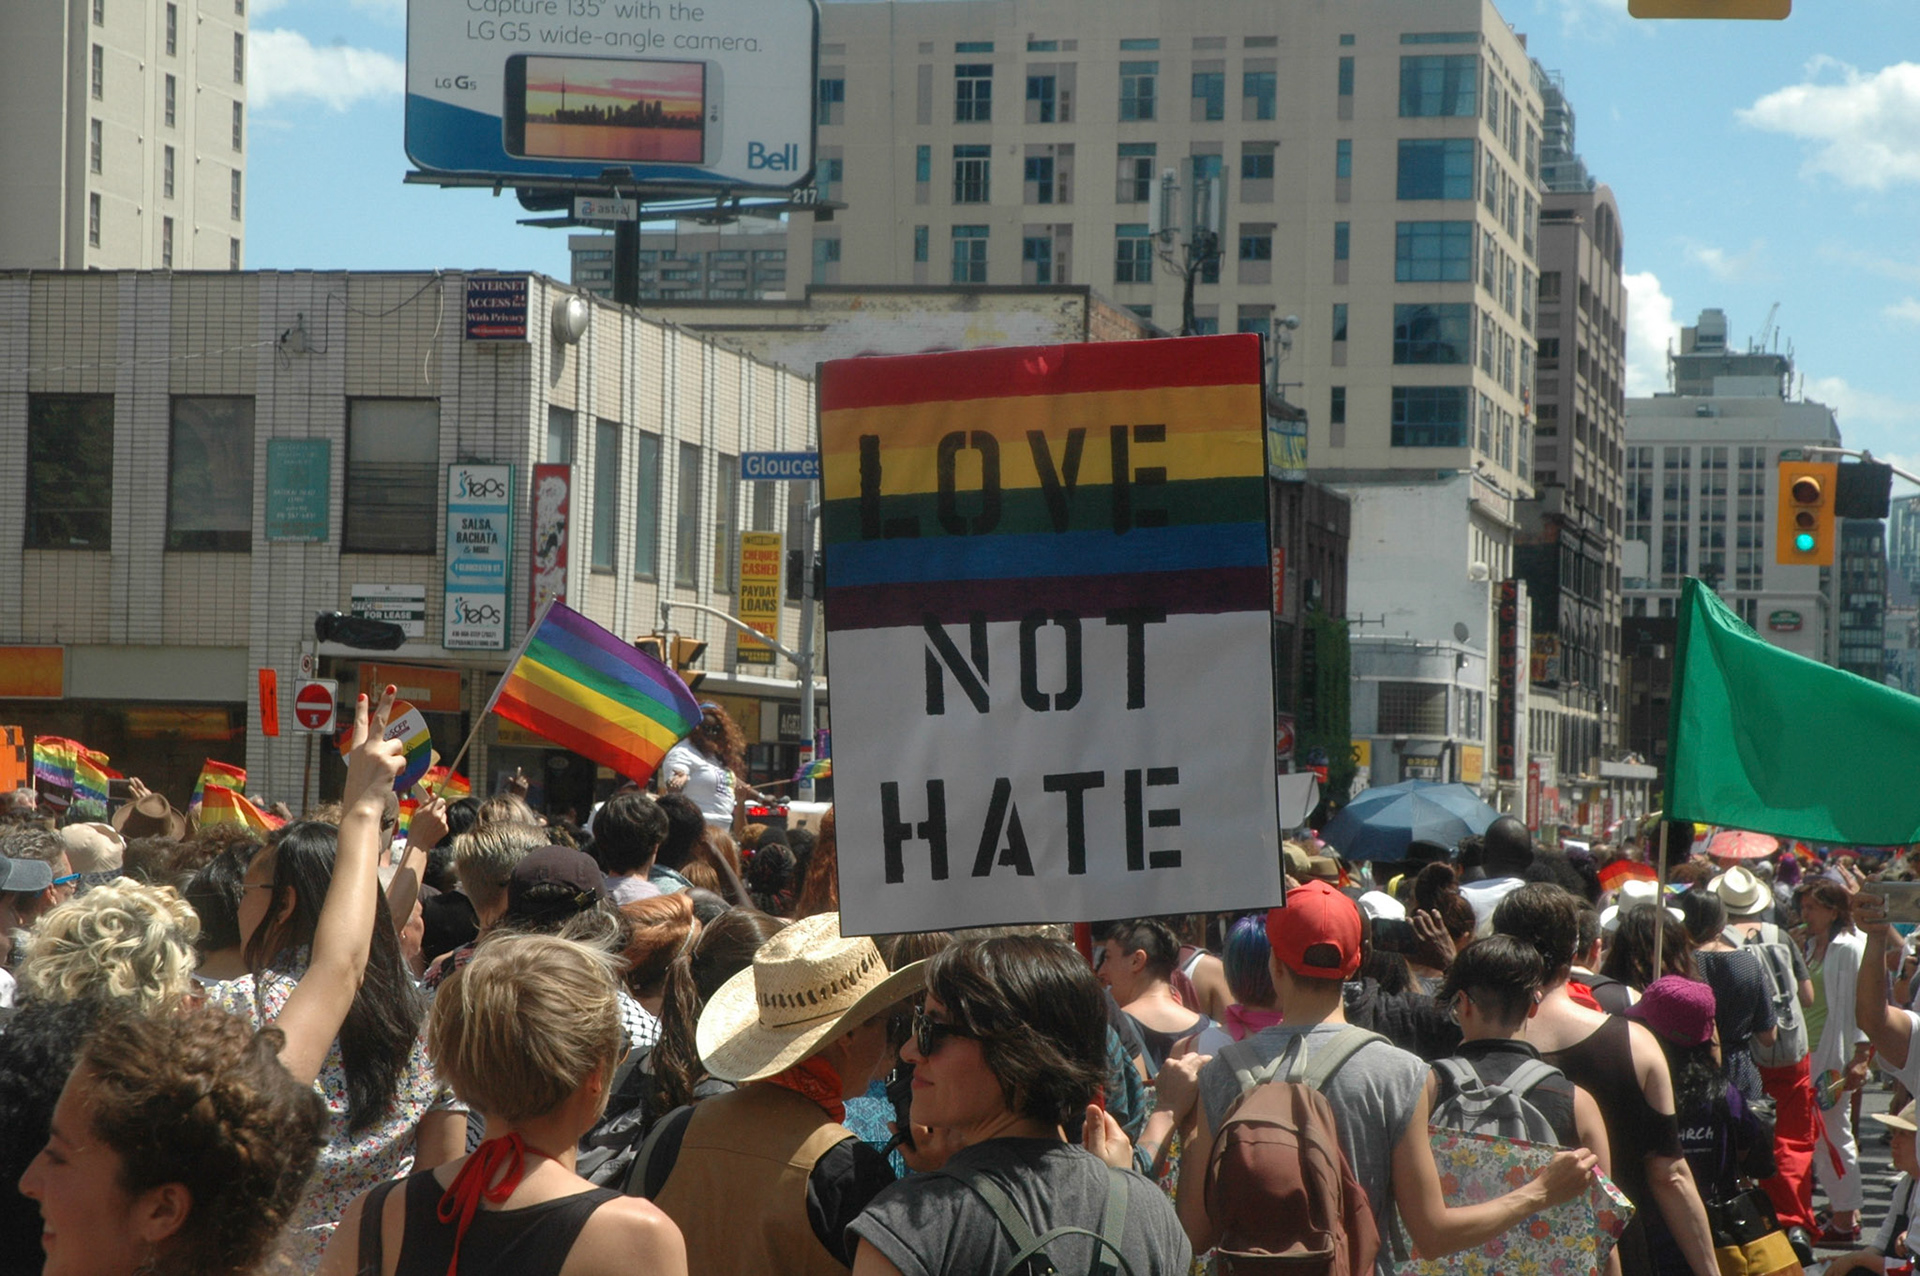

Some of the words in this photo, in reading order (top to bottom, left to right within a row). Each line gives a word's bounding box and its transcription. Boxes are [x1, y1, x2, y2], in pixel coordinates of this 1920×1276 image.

[467, 0, 558, 17] Capture
[615, 0, 661, 20] with
[669, 2, 704, 22] the
[466, 20, 495, 41] LG
[500, 22, 531, 42] G5
[540, 25, 665, 53] wide-angle
[673, 34, 763, 52] camera.
[435, 77, 452, 89] LG
[455, 75, 477, 90] G5
[748, 141, 798, 171] Bell
[792, 188, 818, 204] 217
[467, 280, 526, 291] INTERNET
[468, 297, 511, 308] ACCESS
[467, 313, 490, 322] With
[491, 313, 525, 323] Privacy
[859, 424, 1168, 541] LOVE
[456, 532, 498, 545] BACHATA
[743, 550, 780, 562] CHEQUES
[742, 563, 778, 576] CASHED
[741, 585, 777, 598] PAYDAY
[740, 599, 777, 612] LOANS
[363, 611, 382, 619] FOR
[383, 611, 412, 619] LEASE
[923, 607, 1167, 715] NOT
[1498, 581, 1516, 779] Seduction
[880, 767, 1182, 883] HATE
